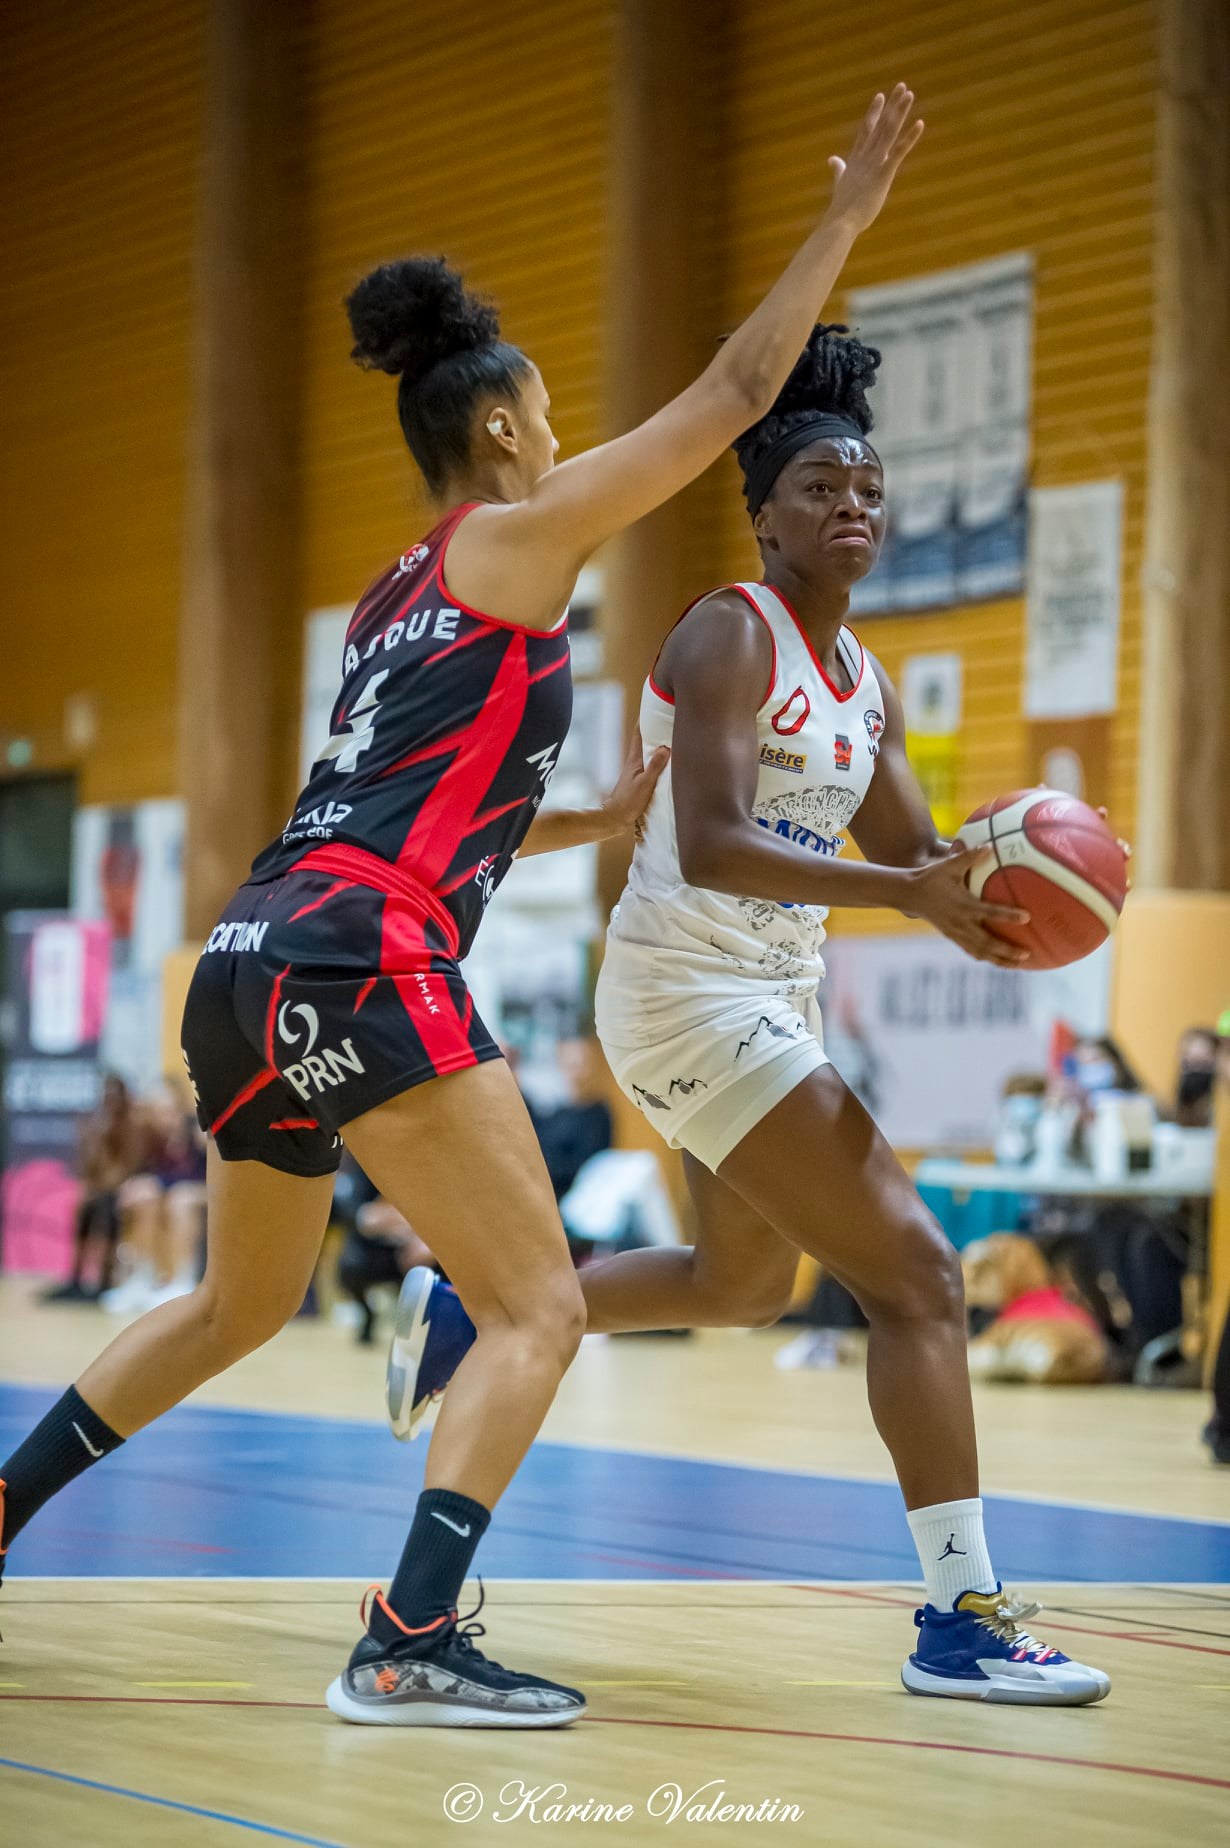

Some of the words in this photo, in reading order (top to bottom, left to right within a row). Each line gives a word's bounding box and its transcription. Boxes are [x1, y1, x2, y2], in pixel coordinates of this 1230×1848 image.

[312, 668, 388, 773] 4
[760, 743, 805, 769] isère
[282, 1037, 366, 1101] PRN
